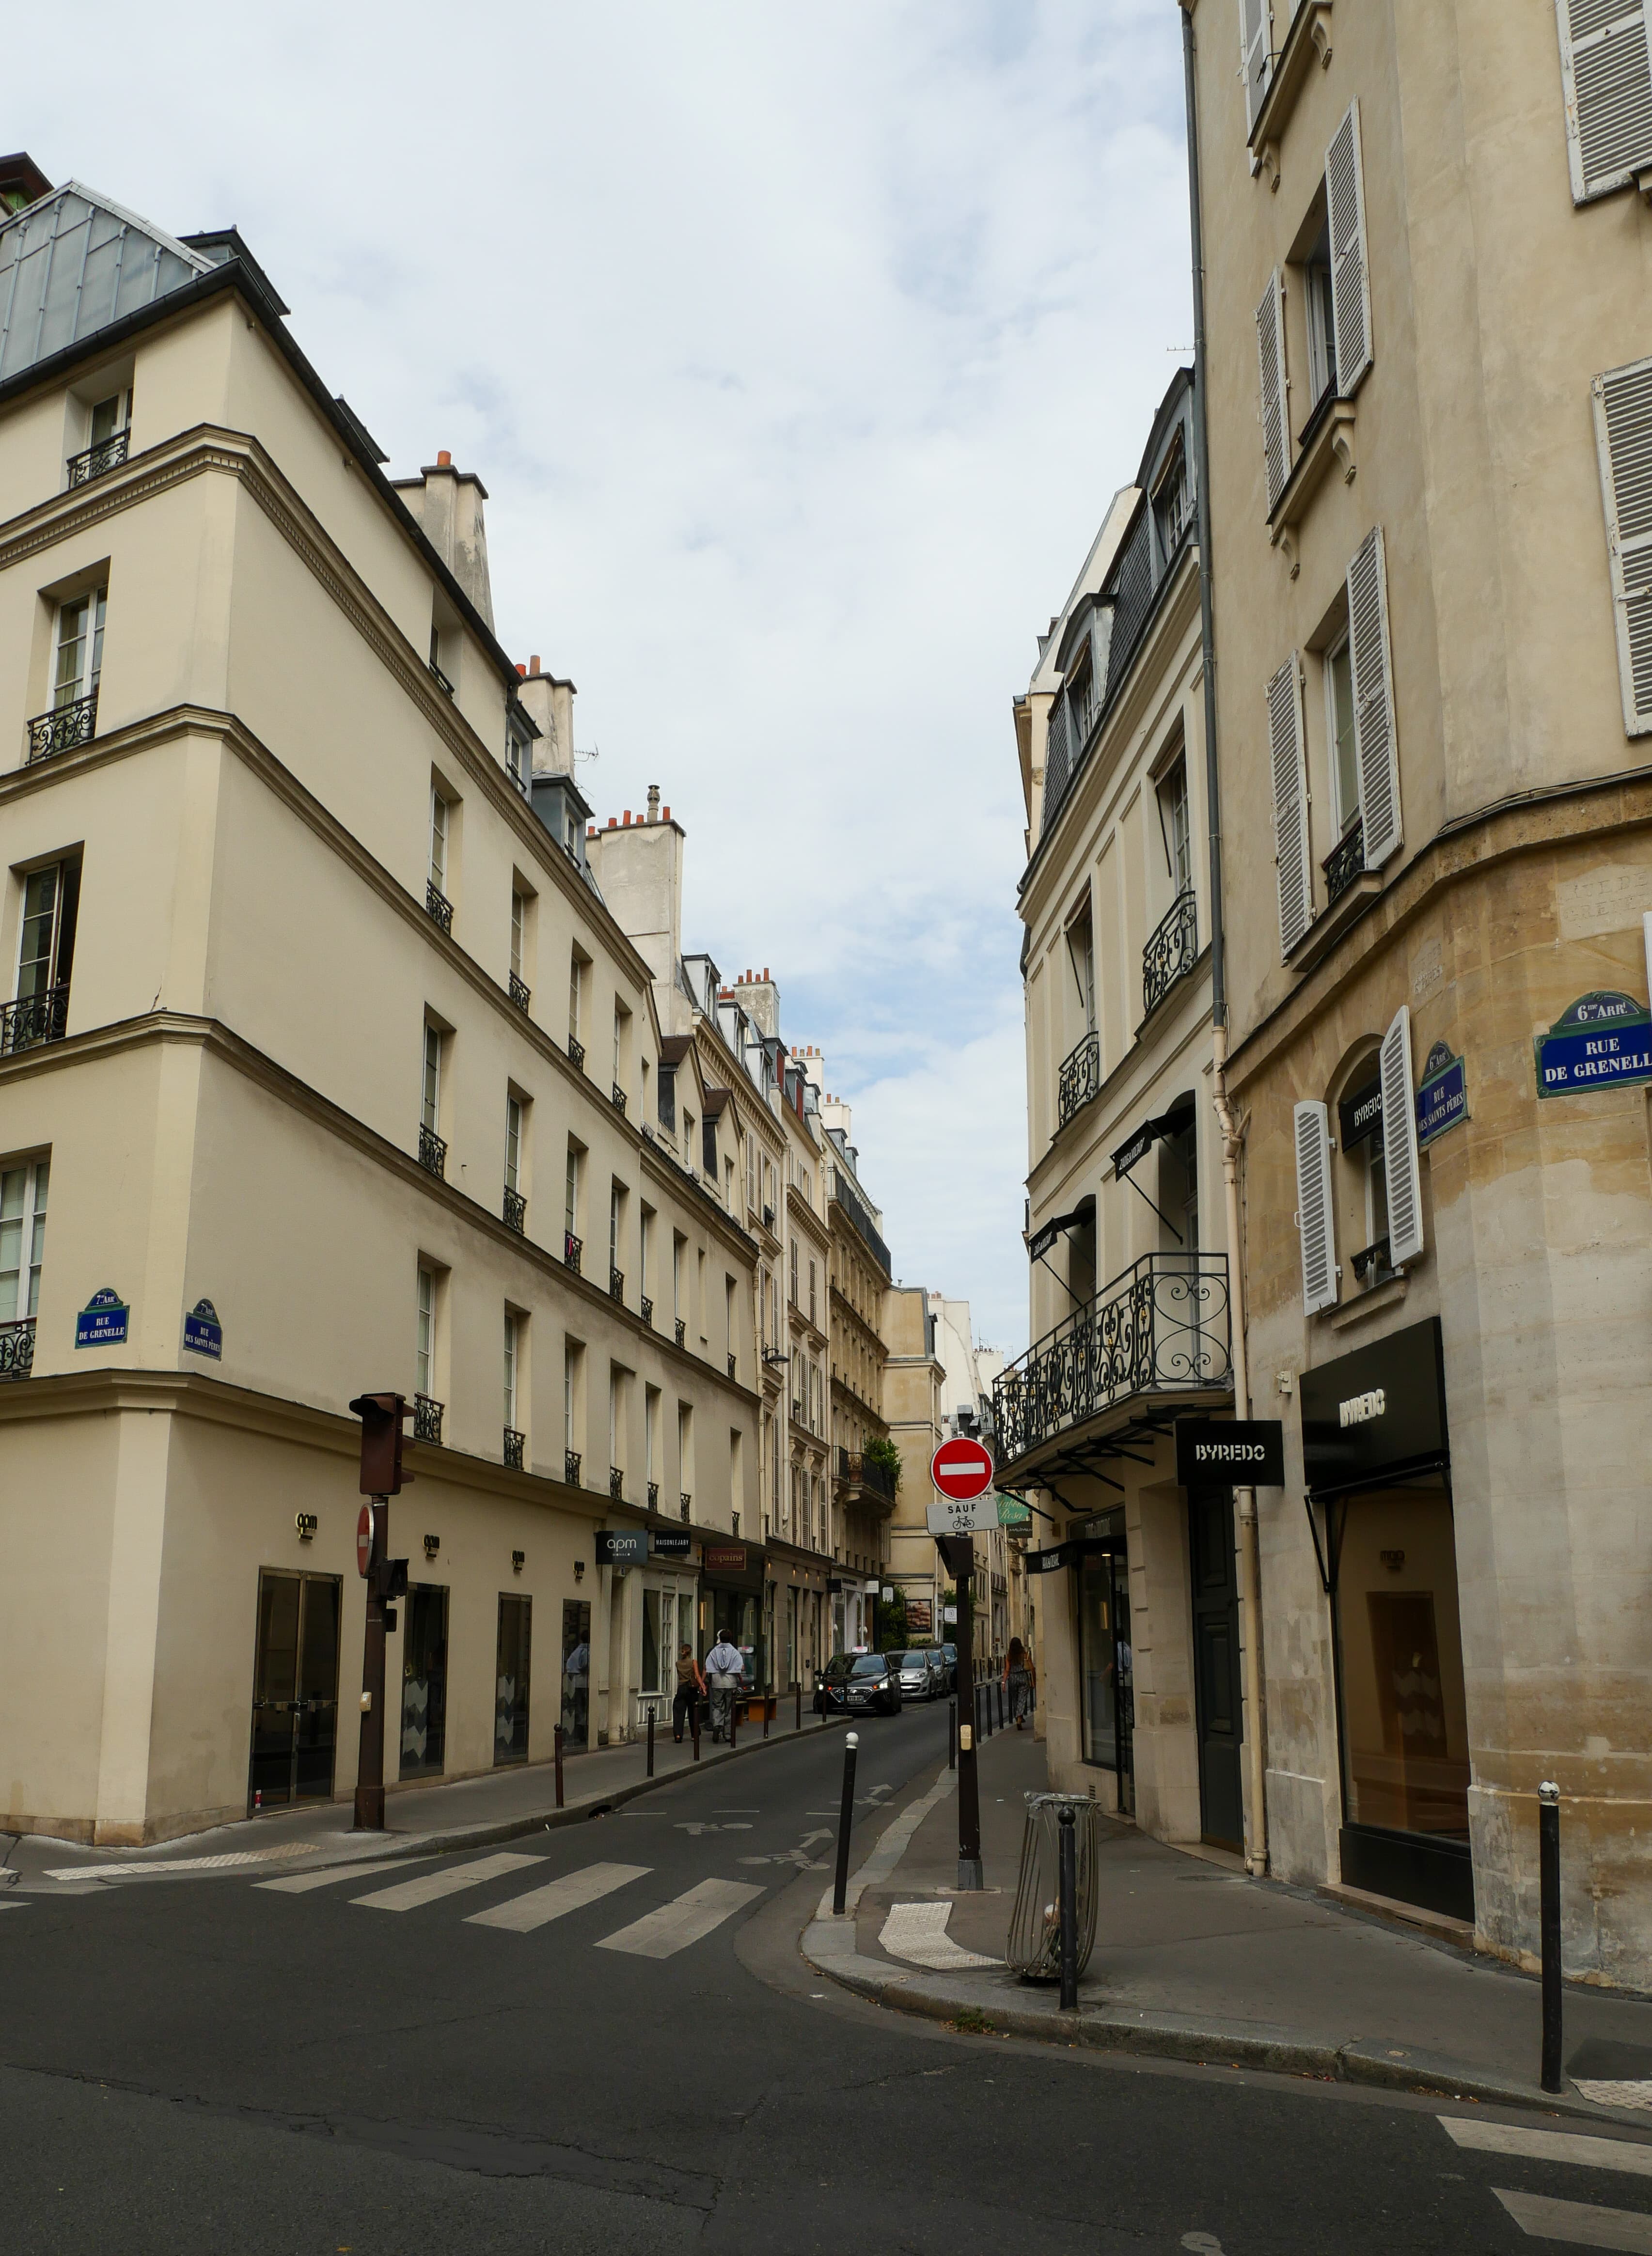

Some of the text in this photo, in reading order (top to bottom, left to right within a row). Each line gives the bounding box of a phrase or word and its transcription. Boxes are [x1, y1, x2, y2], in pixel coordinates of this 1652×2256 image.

[1586, 1038, 1620, 1055] RUE
[1545, 1066, 1567, 1082] DE
[1433, 1086, 1445, 1104] RUE
[1354, 1093, 1382, 1128] BYREDO
[1418, 1092, 1463, 1133] DES SAINTS PÈRES
[96, 1317, 110, 1326] RUE
[79, 1327, 125, 1340] DE GRENELLE
[200, 1327, 209, 1337] RUE
[185, 1333, 193, 1343] DES
[194, 1336, 208, 1348] SAINTS
[1339, 1389, 1385, 1428] BYREDO
[1196, 1445, 1265, 1460] BYREDO
[947, 1504, 976, 1514] SAUF
[999, 1508, 1023, 1520] Rosa
[607, 1539, 637, 1552] apm
[709, 1553, 743, 1563] copains
